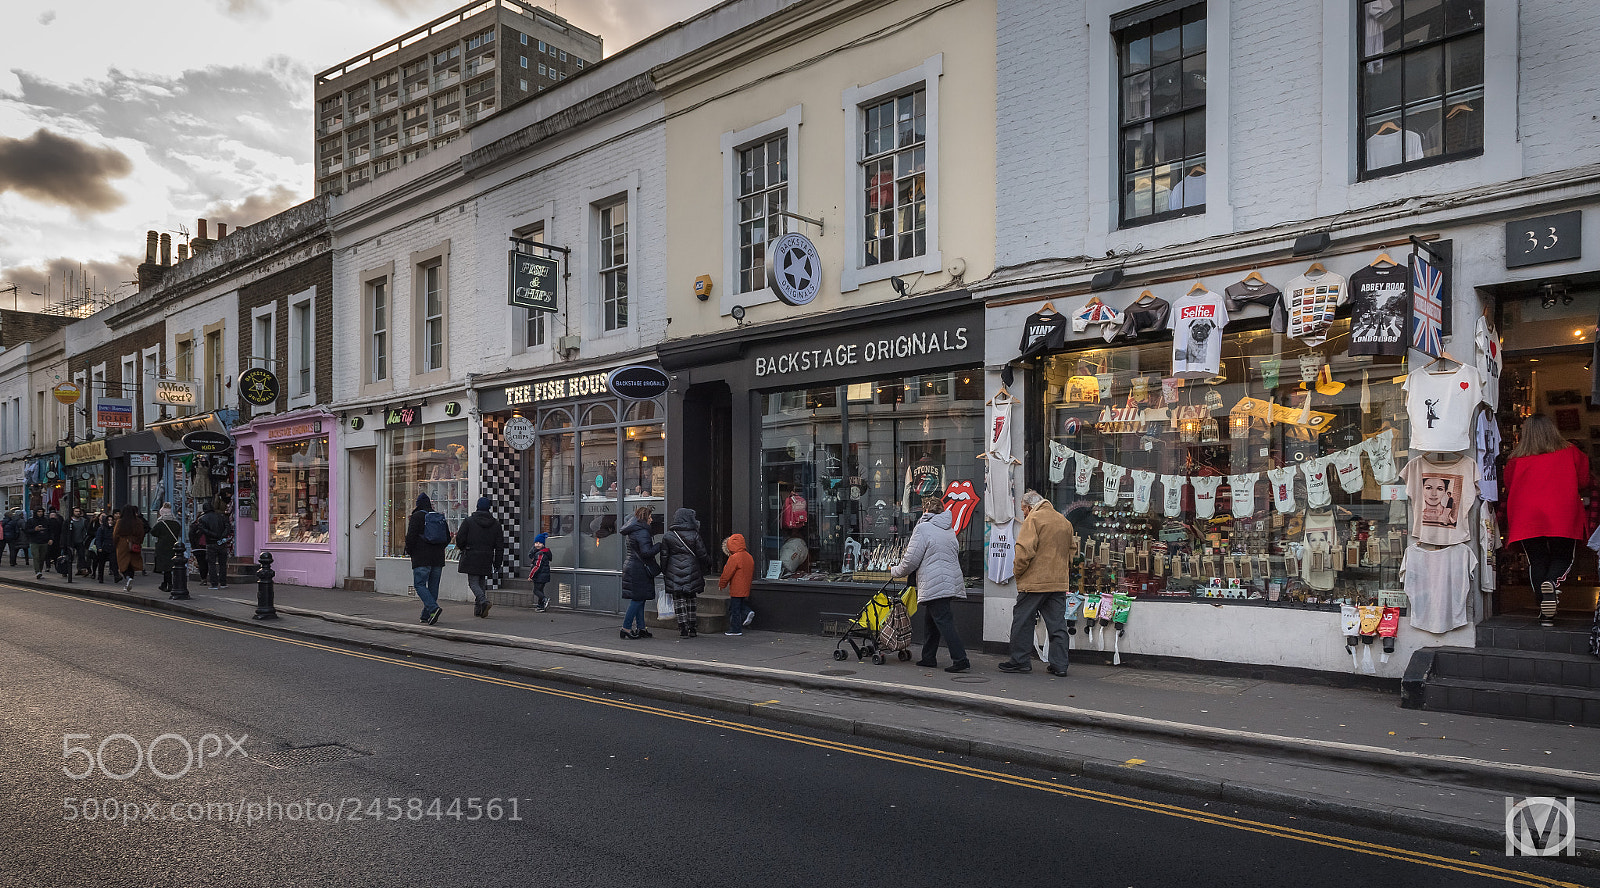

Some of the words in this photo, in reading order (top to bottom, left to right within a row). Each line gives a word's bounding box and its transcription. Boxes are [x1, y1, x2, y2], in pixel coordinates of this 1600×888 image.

[1524, 226, 1558, 253] 33
[781, 238, 815, 259] BACKSTAGE
[520, 262, 549, 277] FISH
[530, 277, 540, 287] &
[782, 280, 815, 299] ORIGINALS
[1361, 283, 1384, 292] ABBEY
[1385, 282, 1405, 290] ROAD
[516, 287, 553, 302] CHIPS
[1183, 305, 1212, 318] Selfie.
[755, 344, 857, 377] BACKSTAGE
[864, 327, 968, 362] ORIGINALS
[158, 382, 190, 392] Who's
[505, 385, 531, 405] THE
[534, 379, 566, 402] FISH
[568, 372, 608, 397] HOUS
[913, 464, 939, 476] STONES
